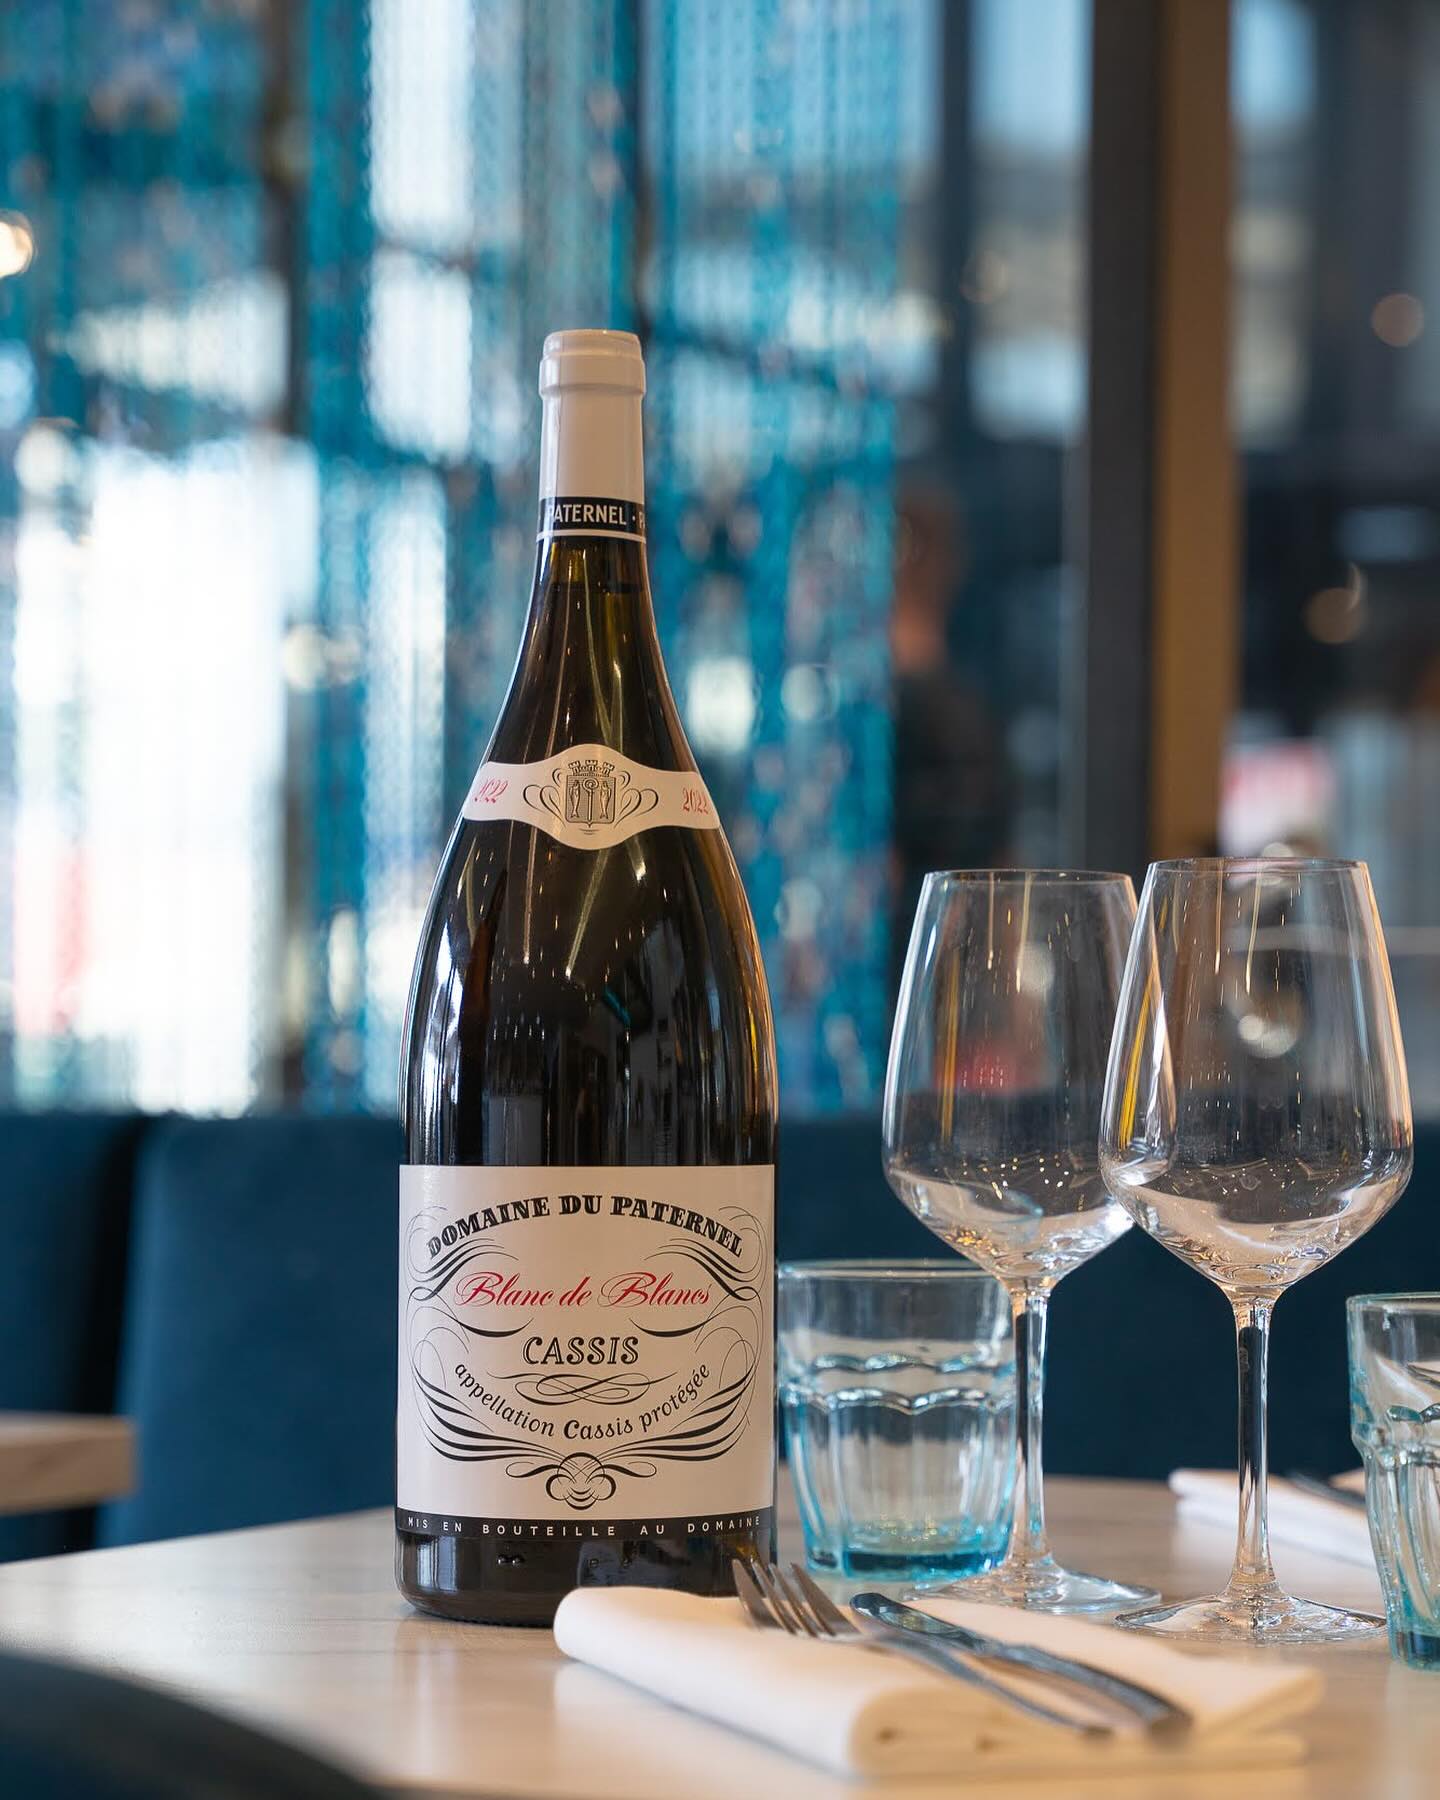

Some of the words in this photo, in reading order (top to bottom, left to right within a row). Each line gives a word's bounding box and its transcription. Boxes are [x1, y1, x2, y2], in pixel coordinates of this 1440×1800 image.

[682, 786, 709, 815] 2022
[425, 1196, 551, 1259] DOMAINE
[558, 1194, 603, 1215] DU
[610, 1195, 744, 1258] PATERNEL
[455, 1271, 553, 1307] Blanc
[558, 1276, 592, 1307] de
[597, 1271, 712, 1308] Blancs
[522, 1335, 640, 1365] CASSIS
[454, 1363, 556, 1437] appellation
[563, 1418, 634, 1440] Cassis
[639, 1363, 711, 1433] protégée
[407, 1516, 429, 1530] MIS
[442, 1521, 463, 1533] EN
[482, 1524, 616, 1537] BOUTEILLE
[640, 1525, 666, 1537] AU
[687, 1515, 761, 1534] DOMAINE
